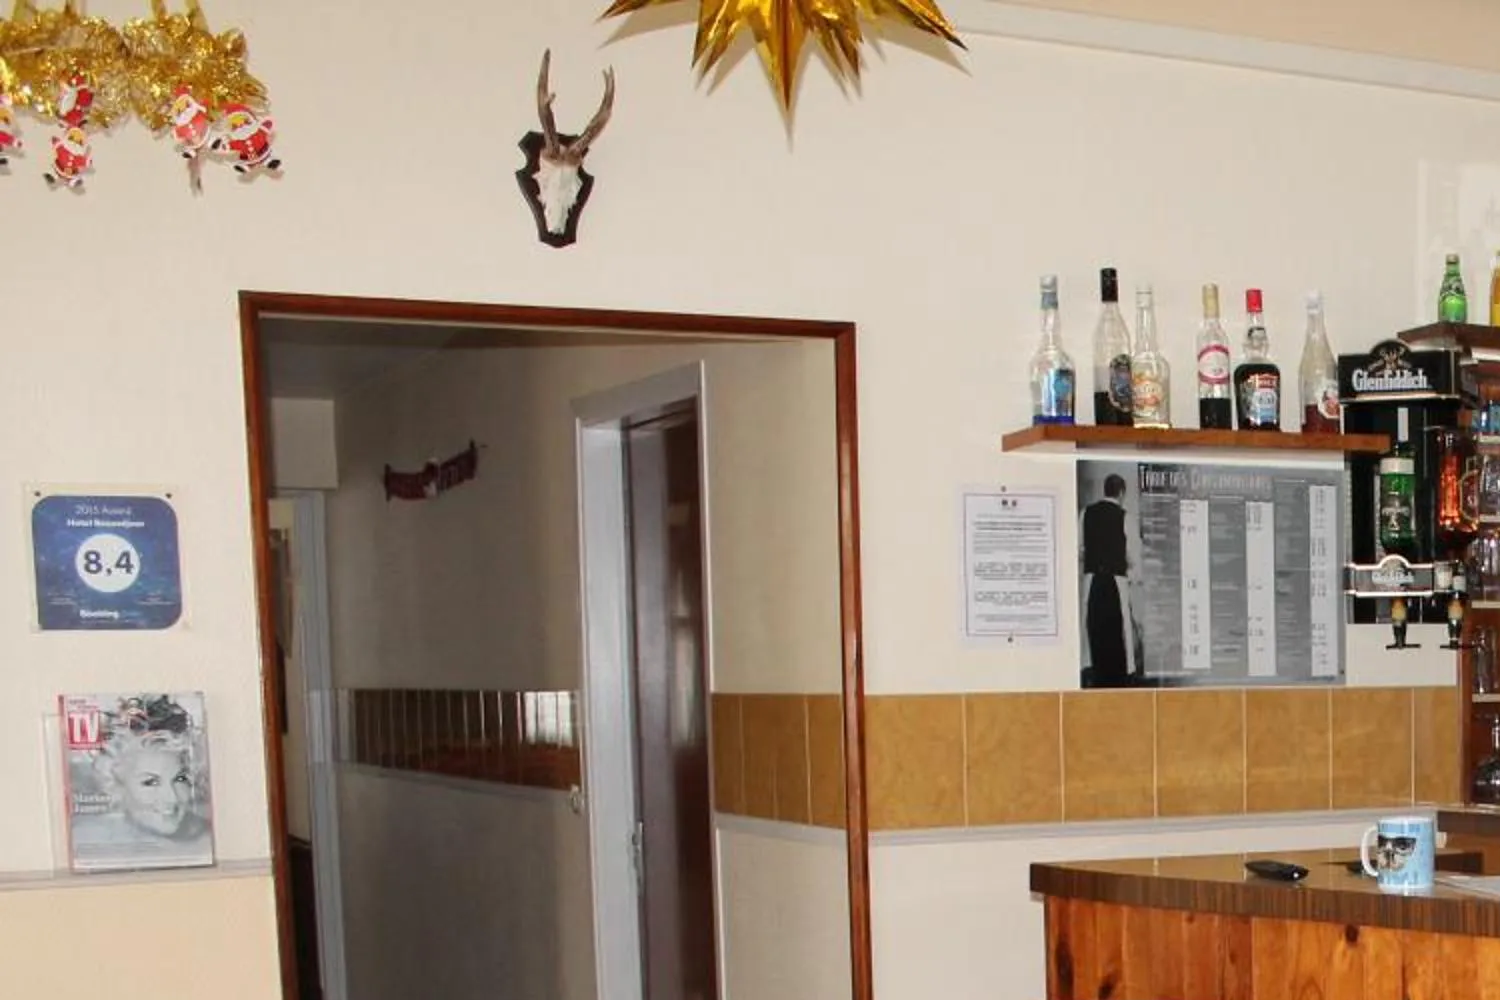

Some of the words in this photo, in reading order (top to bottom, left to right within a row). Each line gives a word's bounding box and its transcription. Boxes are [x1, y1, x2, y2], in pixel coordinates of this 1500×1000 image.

[1352, 367, 1428, 392] Glenfiddich
[83, 550, 135, 577] 8,4
[69, 711, 99, 743] TV
